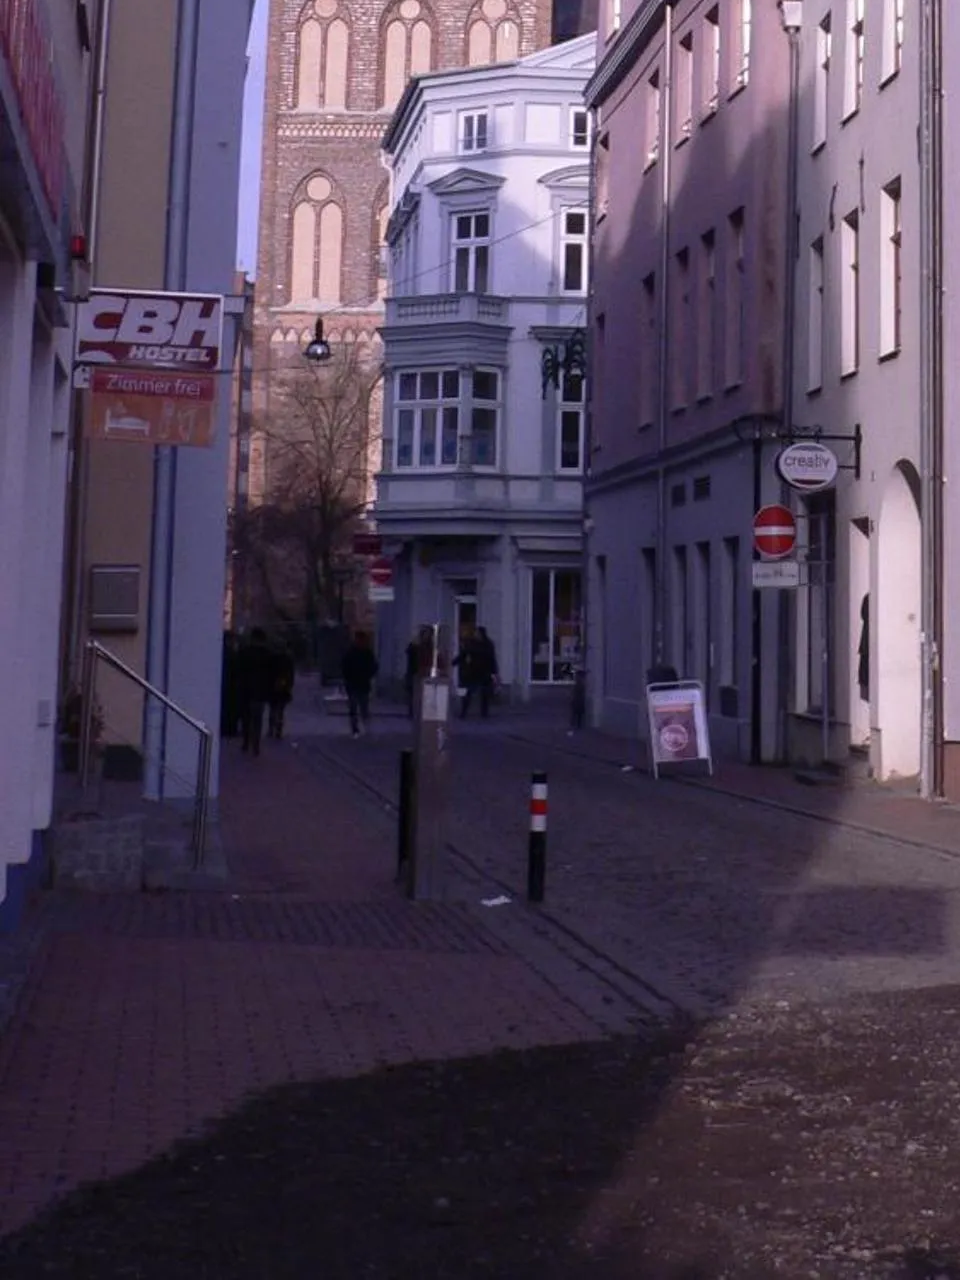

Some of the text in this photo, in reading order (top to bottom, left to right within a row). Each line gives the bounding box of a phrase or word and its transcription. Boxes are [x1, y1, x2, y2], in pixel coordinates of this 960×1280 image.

[78, 295, 221, 347] CBH
[128, 345, 210, 362] HOSTEL
[106, 373, 202, 397] Zimmer frei
[784, 453, 831, 468] creativ
